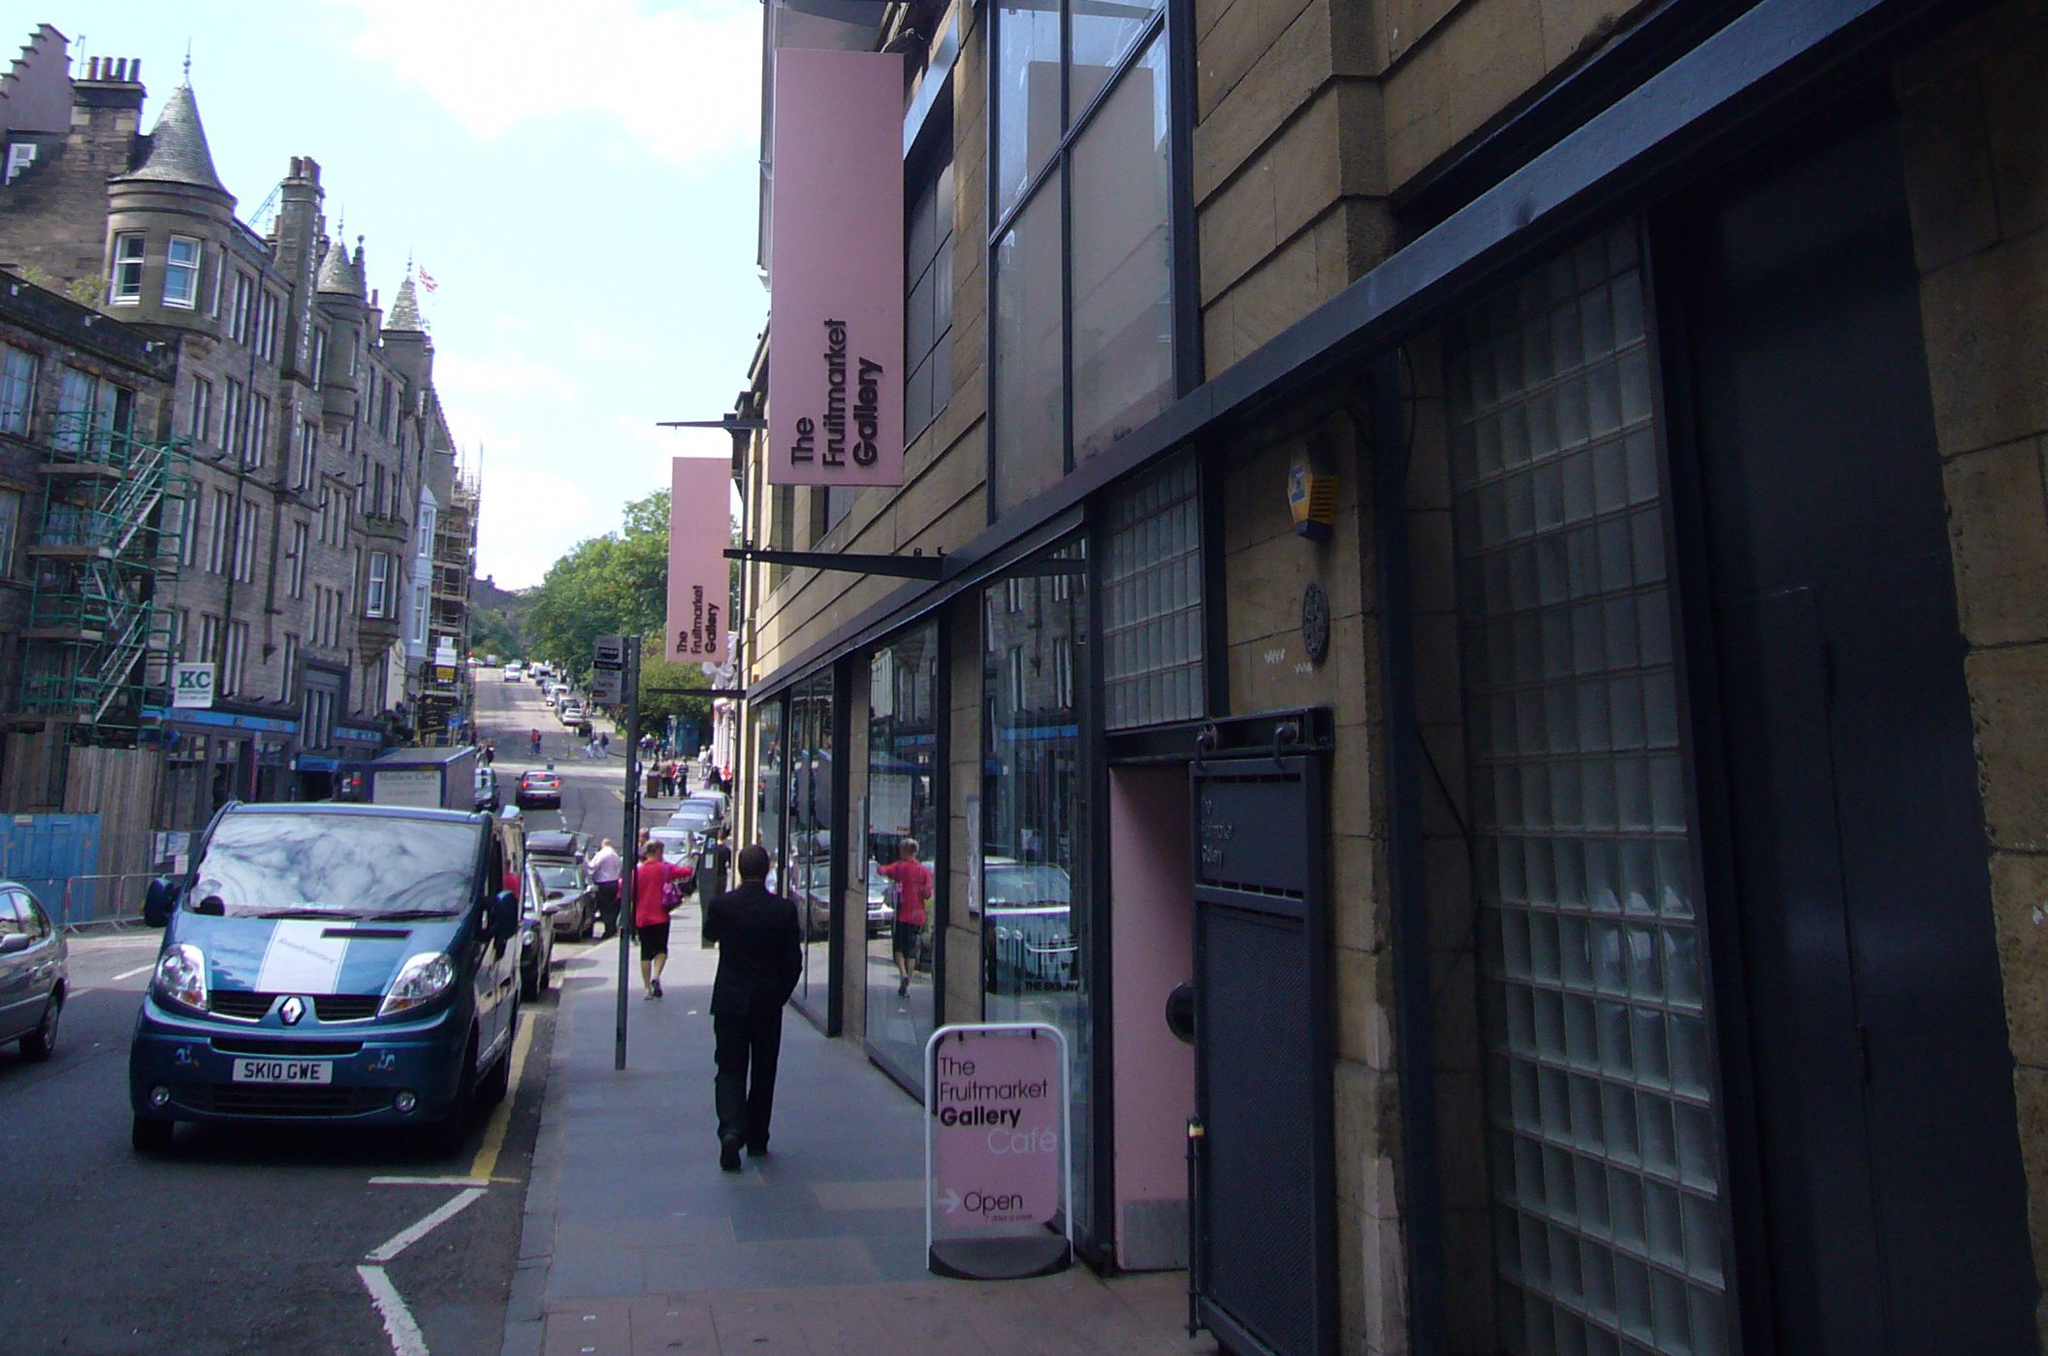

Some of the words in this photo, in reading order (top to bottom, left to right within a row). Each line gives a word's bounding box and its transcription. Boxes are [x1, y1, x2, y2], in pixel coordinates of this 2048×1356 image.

[822, 318, 847, 467] Fruitmarket
[853, 356, 884, 467] Gallery
[791, 416, 814, 466] The
[690, 585, 703, 655] Fruitmarket
[705, 602, 720, 653] Gallery
[676, 630, 688, 654] The
[178, 671, 211, 688] KC
[287, 1063, 322, 1080] GWE
[939, 1056, 976, 1077] The
[939, 1078, 1048, 1102] Fruitmarket
[940, 1106, 1022, 1129] Gallery
[987, 1124, 1058, 1155] Café
[963, 1190, 1024, 1216] Open
